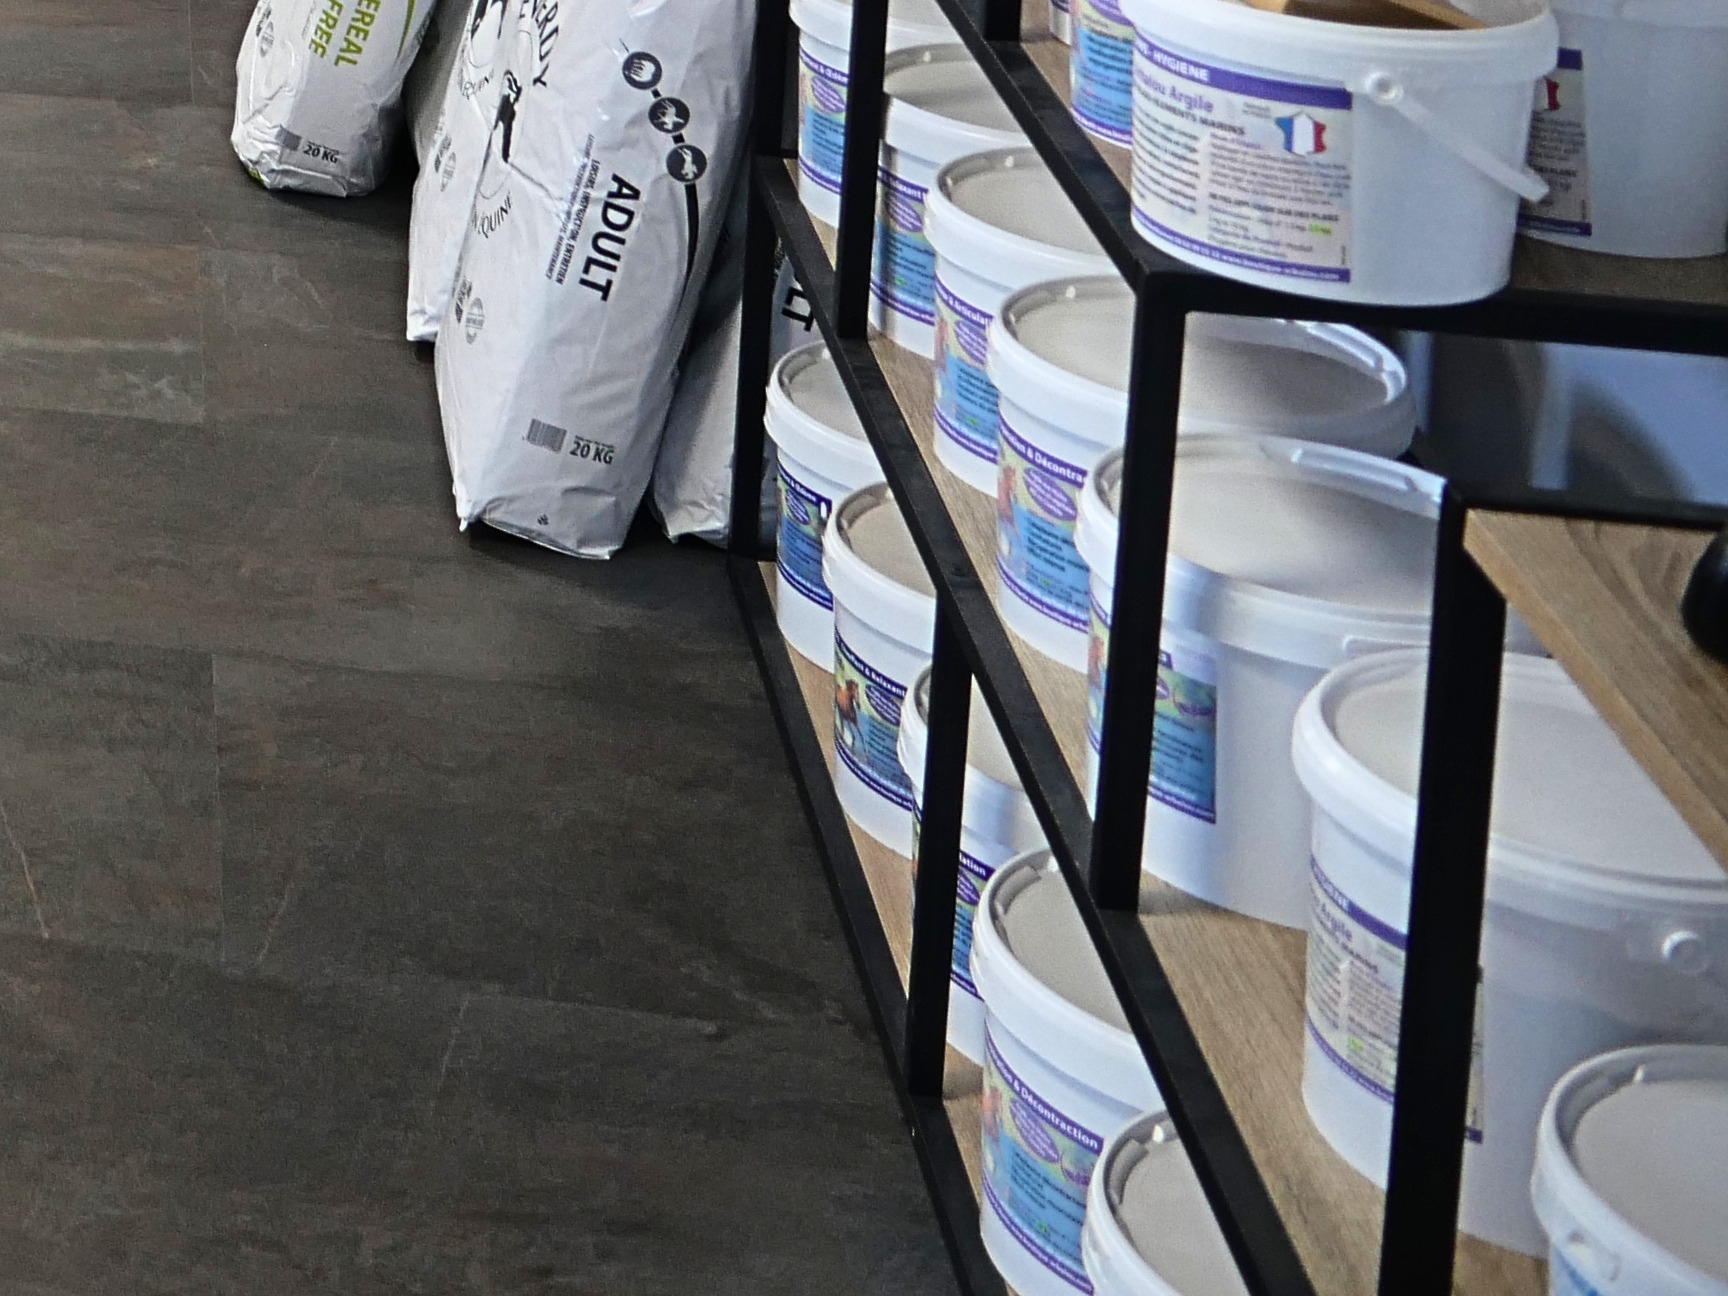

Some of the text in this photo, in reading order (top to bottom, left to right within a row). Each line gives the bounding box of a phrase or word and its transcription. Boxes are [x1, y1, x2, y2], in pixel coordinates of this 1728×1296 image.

[1153, 48, 1210, 81] HYGIENE
[1169, 84, 1215, 114] Argile
[302, 143, 339, 164] 20 KG
[578, 173, 642, 302] ADULT
[570, 440, 615, 465] 20 KG
[1020, 1089, 1099, 1150] Décontraction
